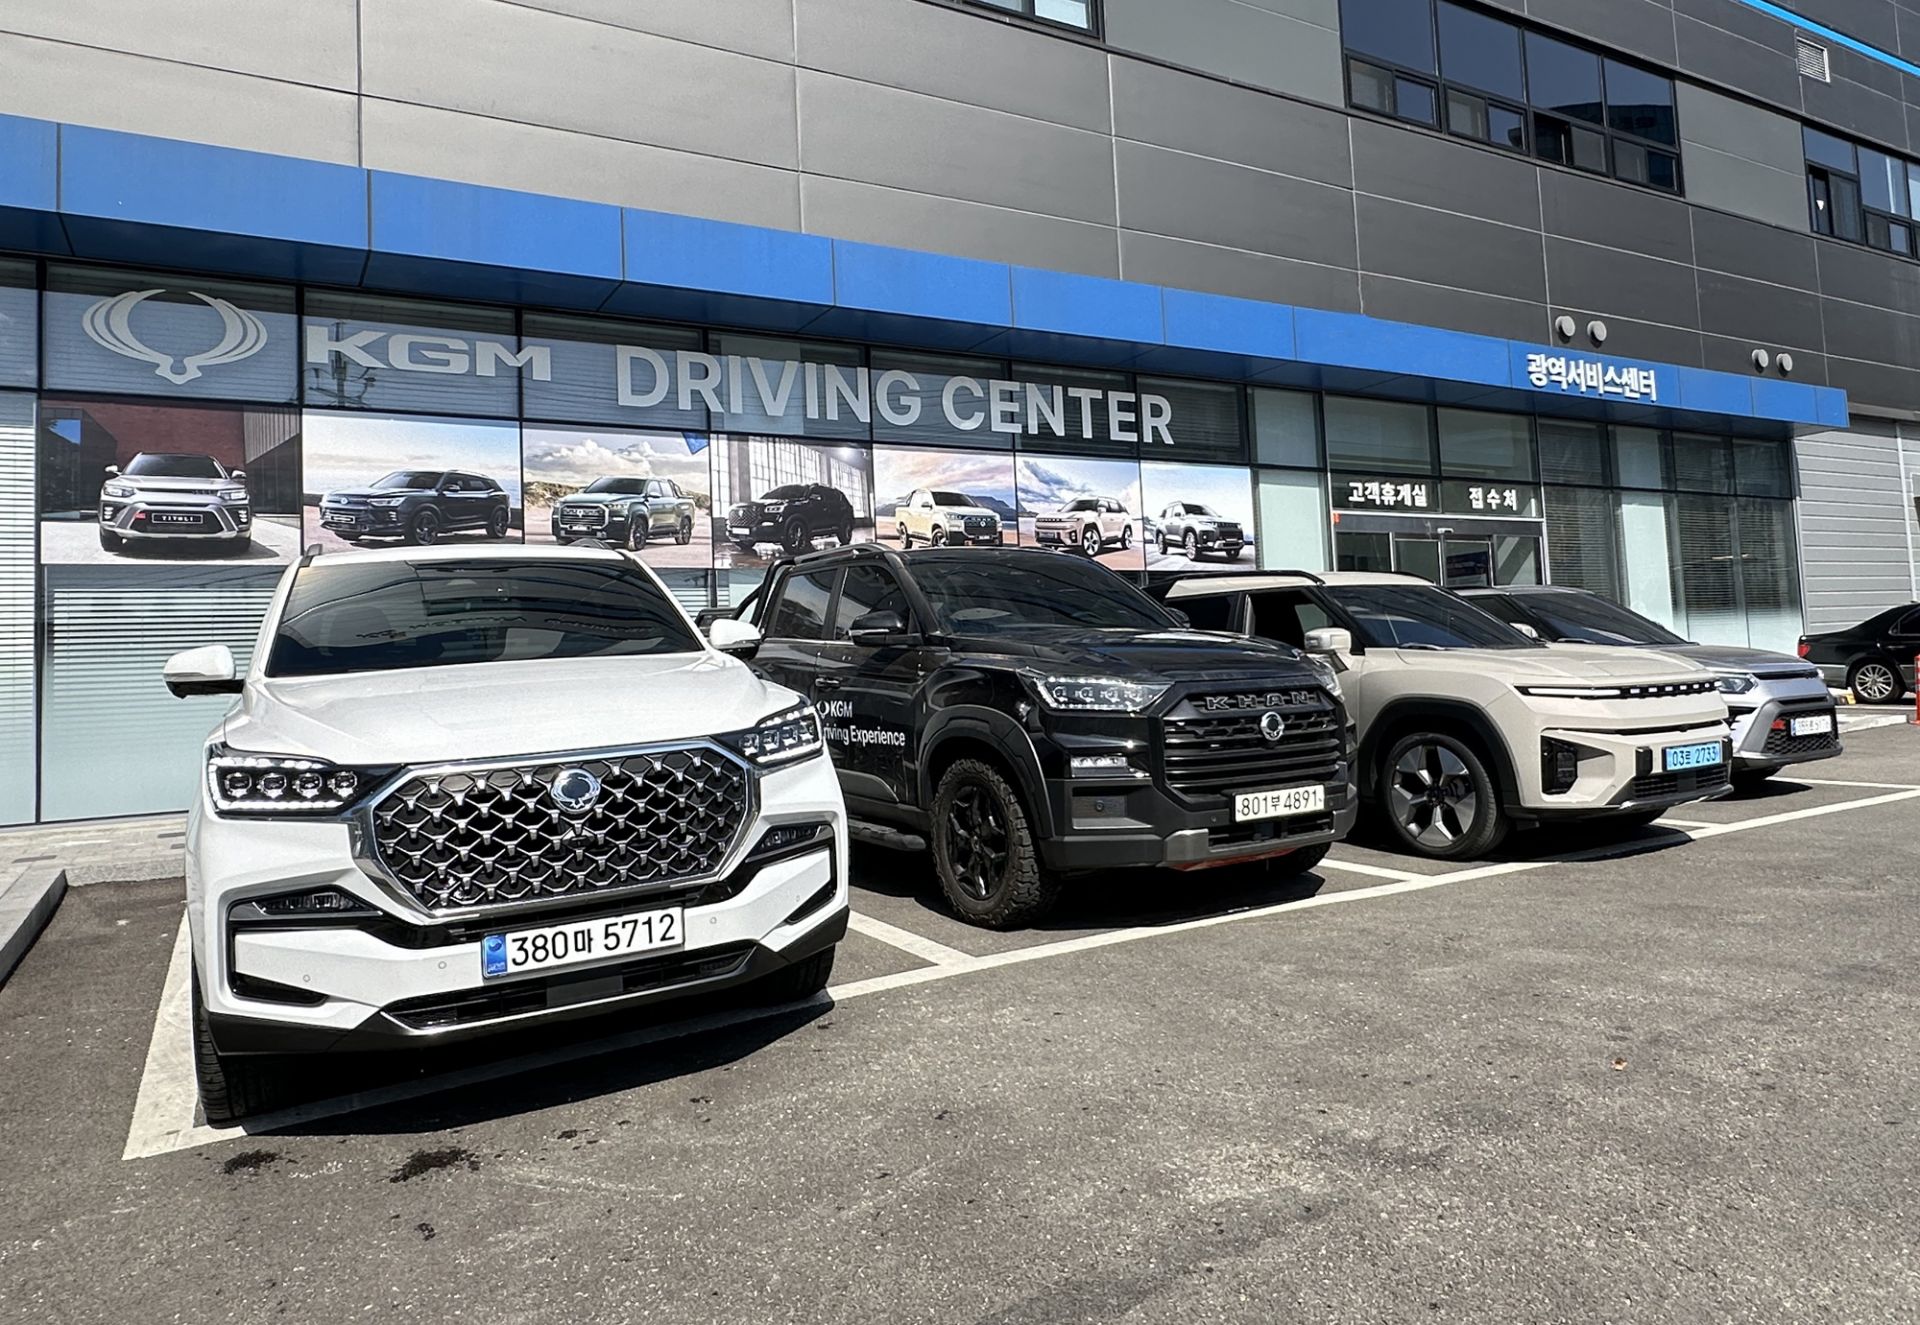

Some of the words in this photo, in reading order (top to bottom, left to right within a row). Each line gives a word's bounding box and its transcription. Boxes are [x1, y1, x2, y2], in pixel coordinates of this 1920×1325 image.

[306, 325, 551, 382] KGM
[616, 345, 921, 426] DRIVING
[942, 375, 1174, 445] CENTER
[1526, 353, 1656, 402] 광역서비스센터
[1348, 482, 1427, 507] 고객휴게실
[830, 700, 853, 718] KGM
[1205, 691, 1310, 710] KHAN
[823, 723, 849, 746] riving
[850, 725, 905, 748] Experience
[1284, 790, 1318, 811] 4891
[511, 931, 593, 966] 380마
[603, 914, 675, 951] 5712
